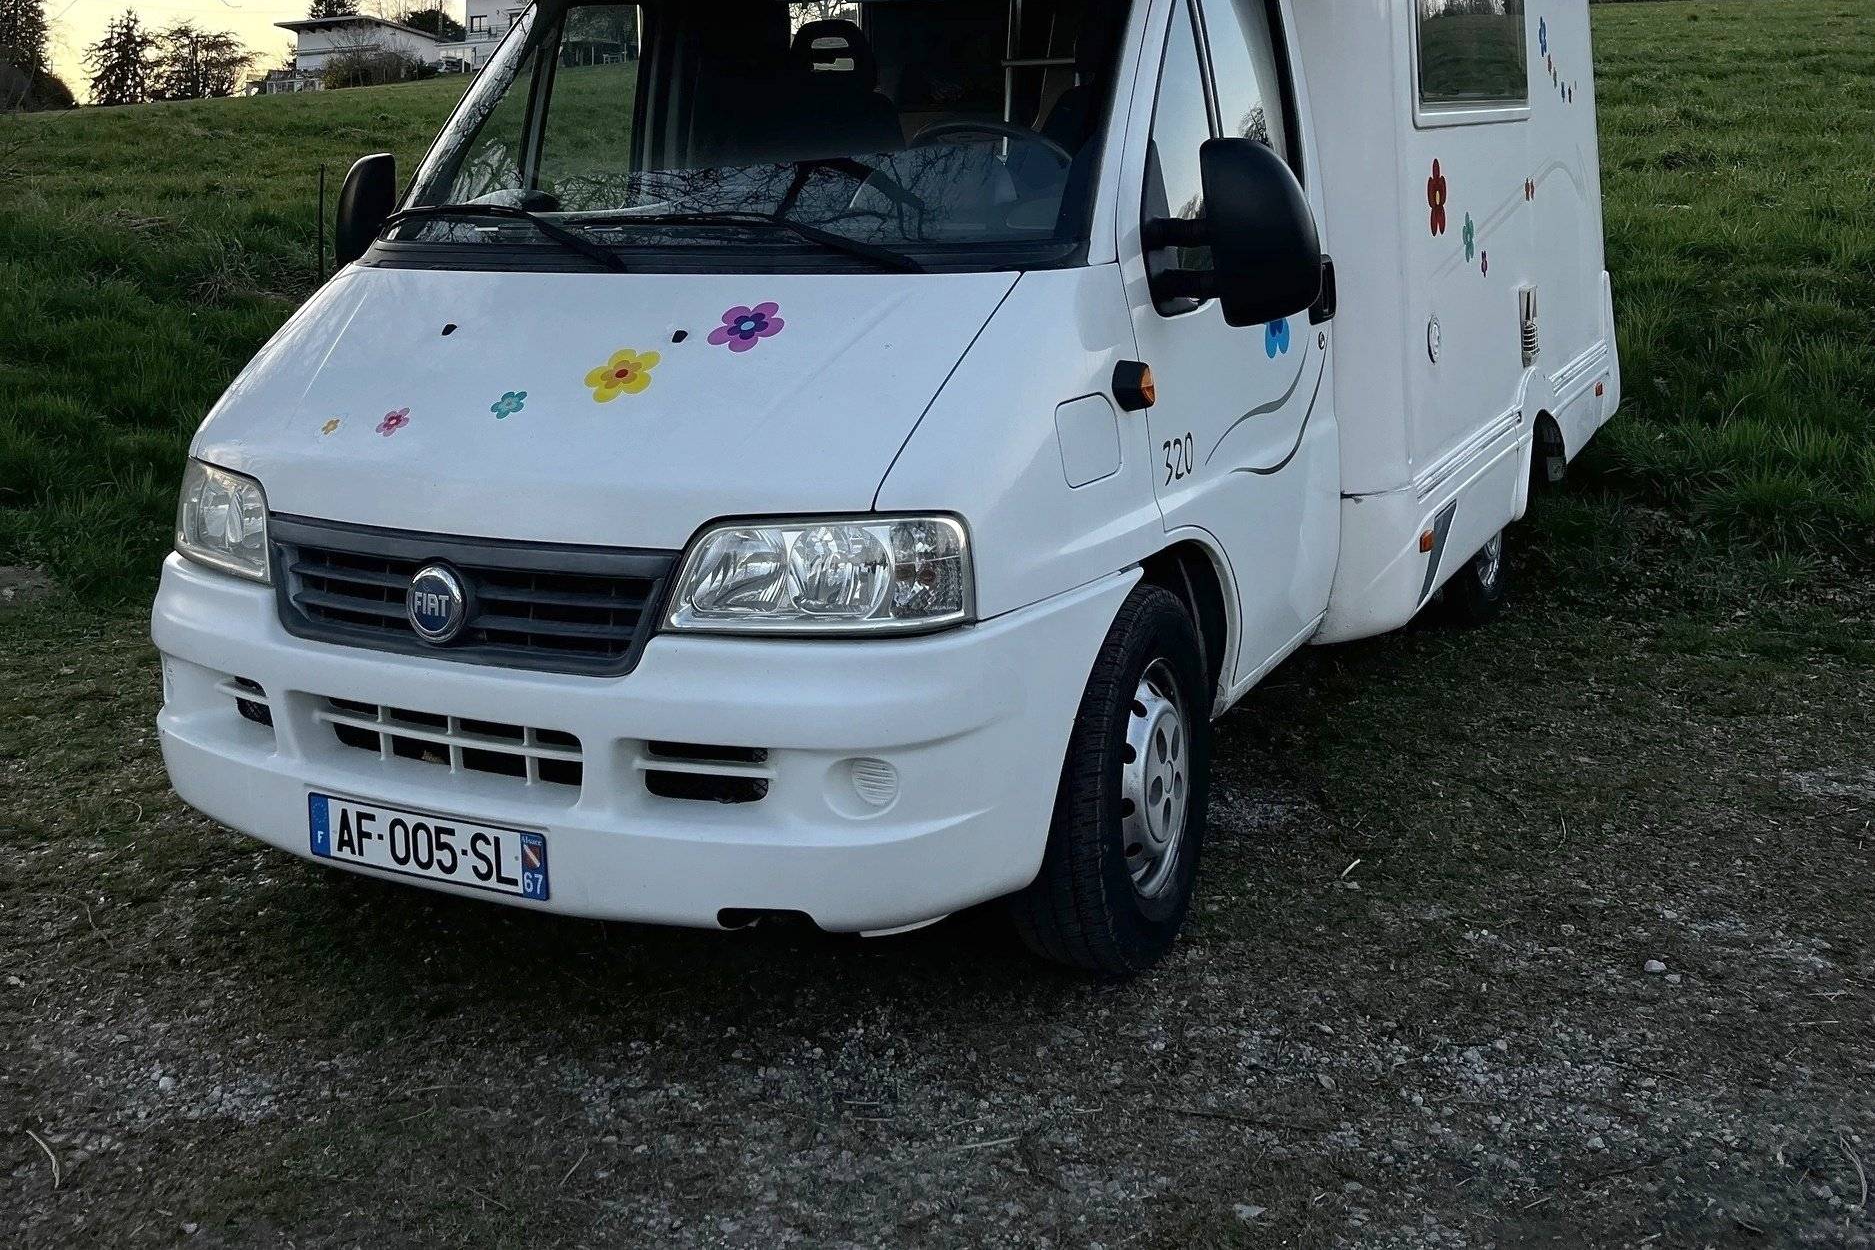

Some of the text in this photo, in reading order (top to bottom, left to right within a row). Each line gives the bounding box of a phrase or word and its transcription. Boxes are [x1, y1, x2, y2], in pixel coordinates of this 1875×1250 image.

[1163, 432, 1193, 486] 320
[414, 591, 449, 617] FIAT
[317, 830, 324, 844] F
[523, 871, 543, 895] 67
